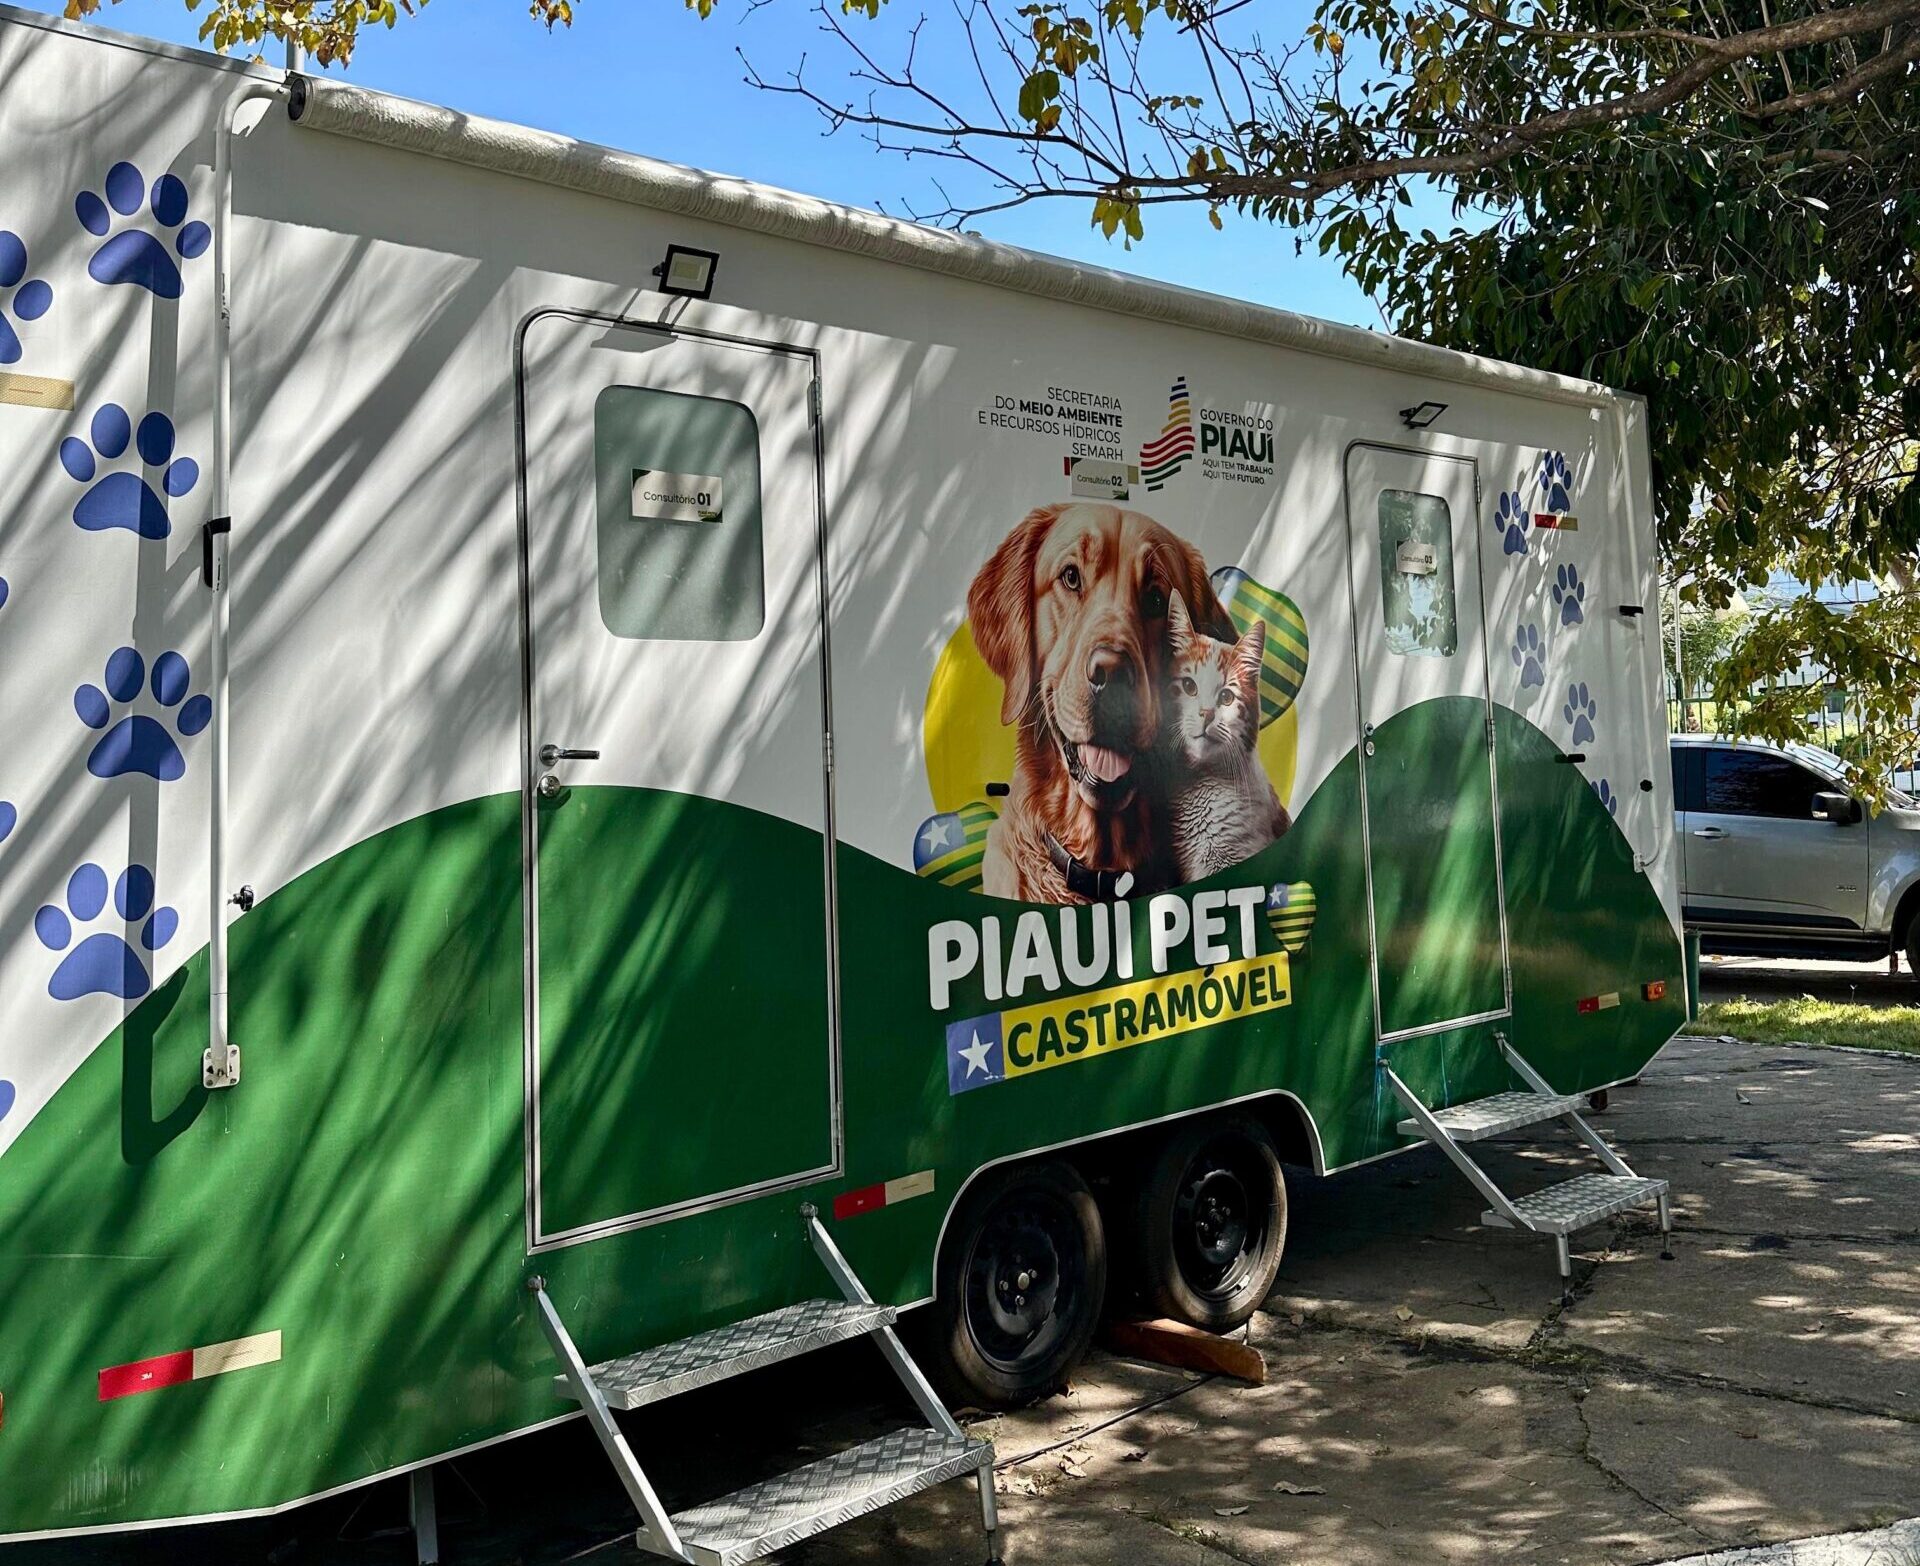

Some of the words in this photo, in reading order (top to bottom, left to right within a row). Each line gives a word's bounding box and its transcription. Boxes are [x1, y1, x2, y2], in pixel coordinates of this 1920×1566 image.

[1047, 386, 1122, 411] SECRETARIA
[995, 395, 1015, 410] DO
[1020, 399, 1053, 416] MEIO
[1057, 406, 1123, 428] AMBIENTE
[1200, 409, 1254, 428] GOVERNO
[1258, 418, 1273, 431] DO
[978, 411, 986, 424] E
[990, 412, 1060, 435] RECURSOS
[1063, 422, 1121, 444] HÍDRICOS
[1072, 442, 1123, 461] SEMARH
[1200, 423, 1274, 464] PIAUÍ
[1202, 458, 1220, 468] AQUI
[1221, 460, 1235, 470] TEM
[1236, 463, 1274, 475] TRABALHO
[1202, 469, 1220, 480] AQUI
[1222, 471, 1236, 481] TEM
[1111, 475, 1123, 487] 02
[643, 491, 696, 505] Consultório
[697, 492, 711, 506] 01
[1425, 555, 1433, 565] 03
[928, 872, 1134, 1011] PIAUÍ
[1149, 885, 1266, 974] PET
[1007, 964, 1287, 1068] CASTRAMÓVEL
